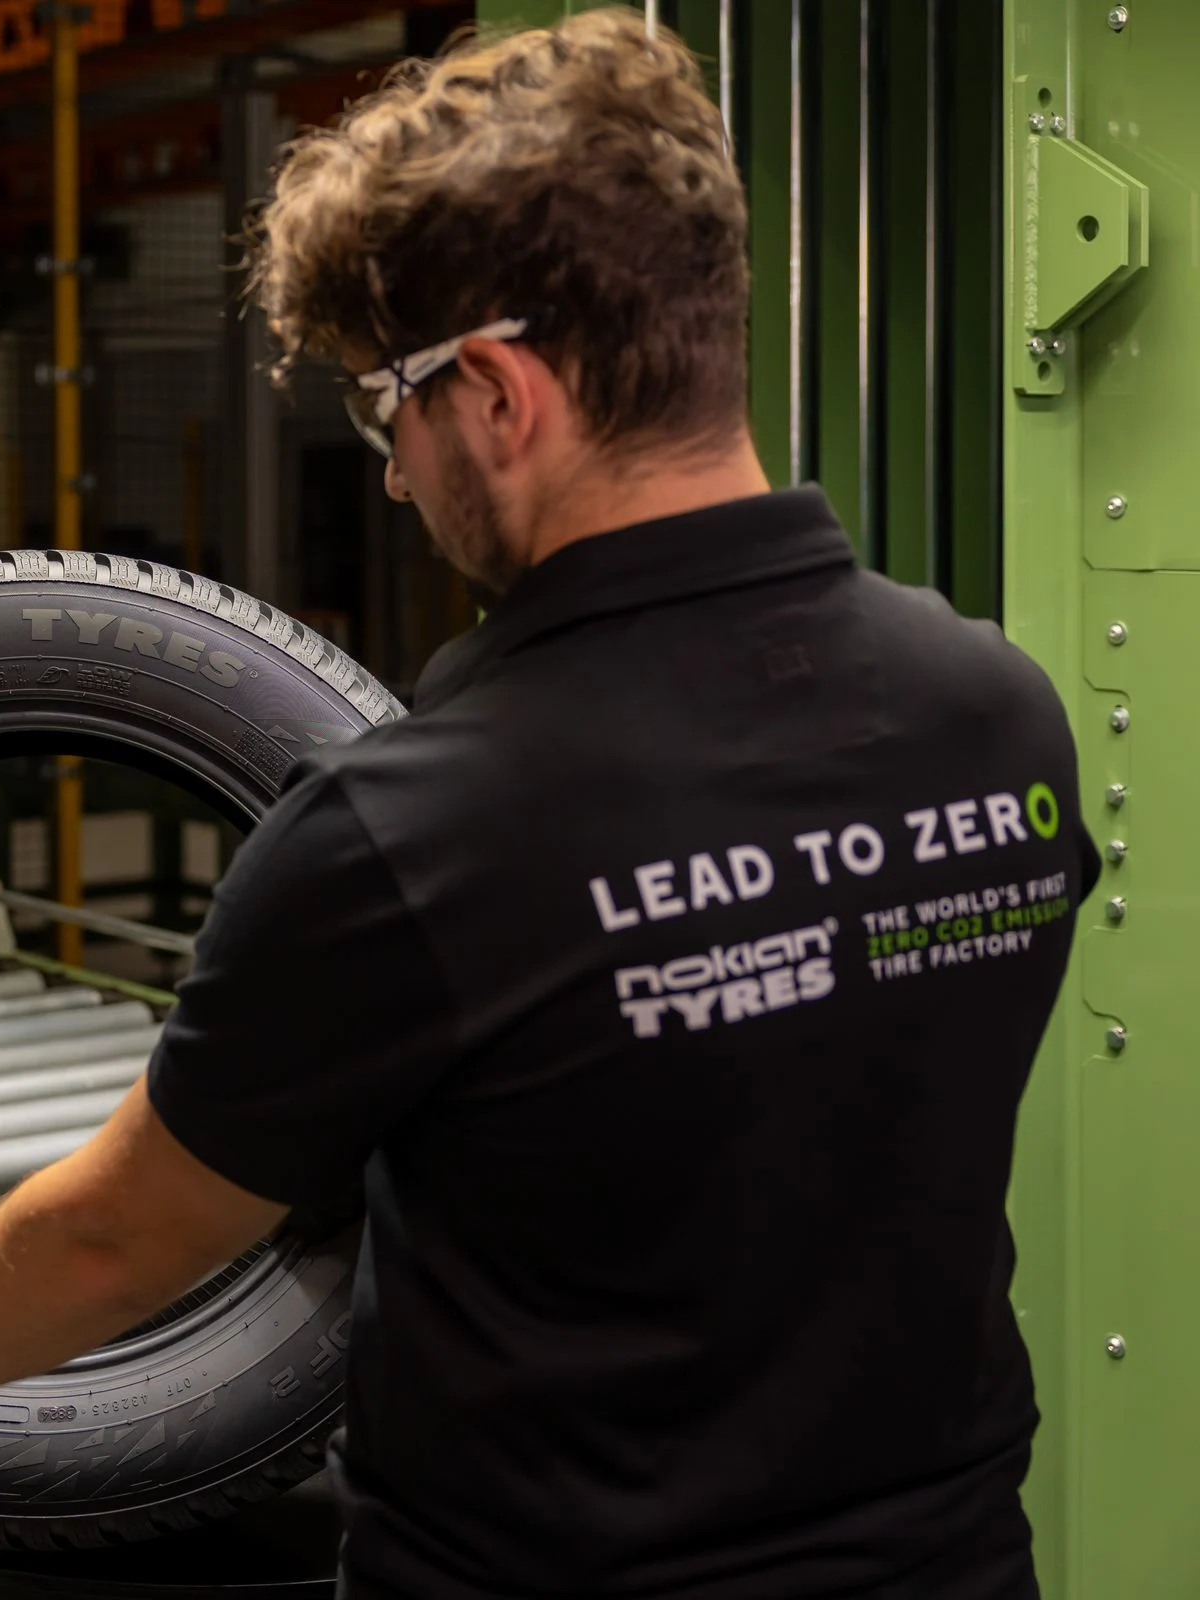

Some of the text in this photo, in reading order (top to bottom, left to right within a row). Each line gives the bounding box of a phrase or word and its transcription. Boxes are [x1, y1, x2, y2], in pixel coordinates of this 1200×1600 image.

[21, 607, 248, 690] TYRES
[589, 781, 1059, 933] LEAD TO ZERO
[862, 905, 910, 935] THE
[915, 883, 1021, 925] WORLD'S
[867, 925, 929, 958] ZERO
[868, 928, 1033, 982] TIRE FACTORY
[620, 957, 836, 1038] TYRES
